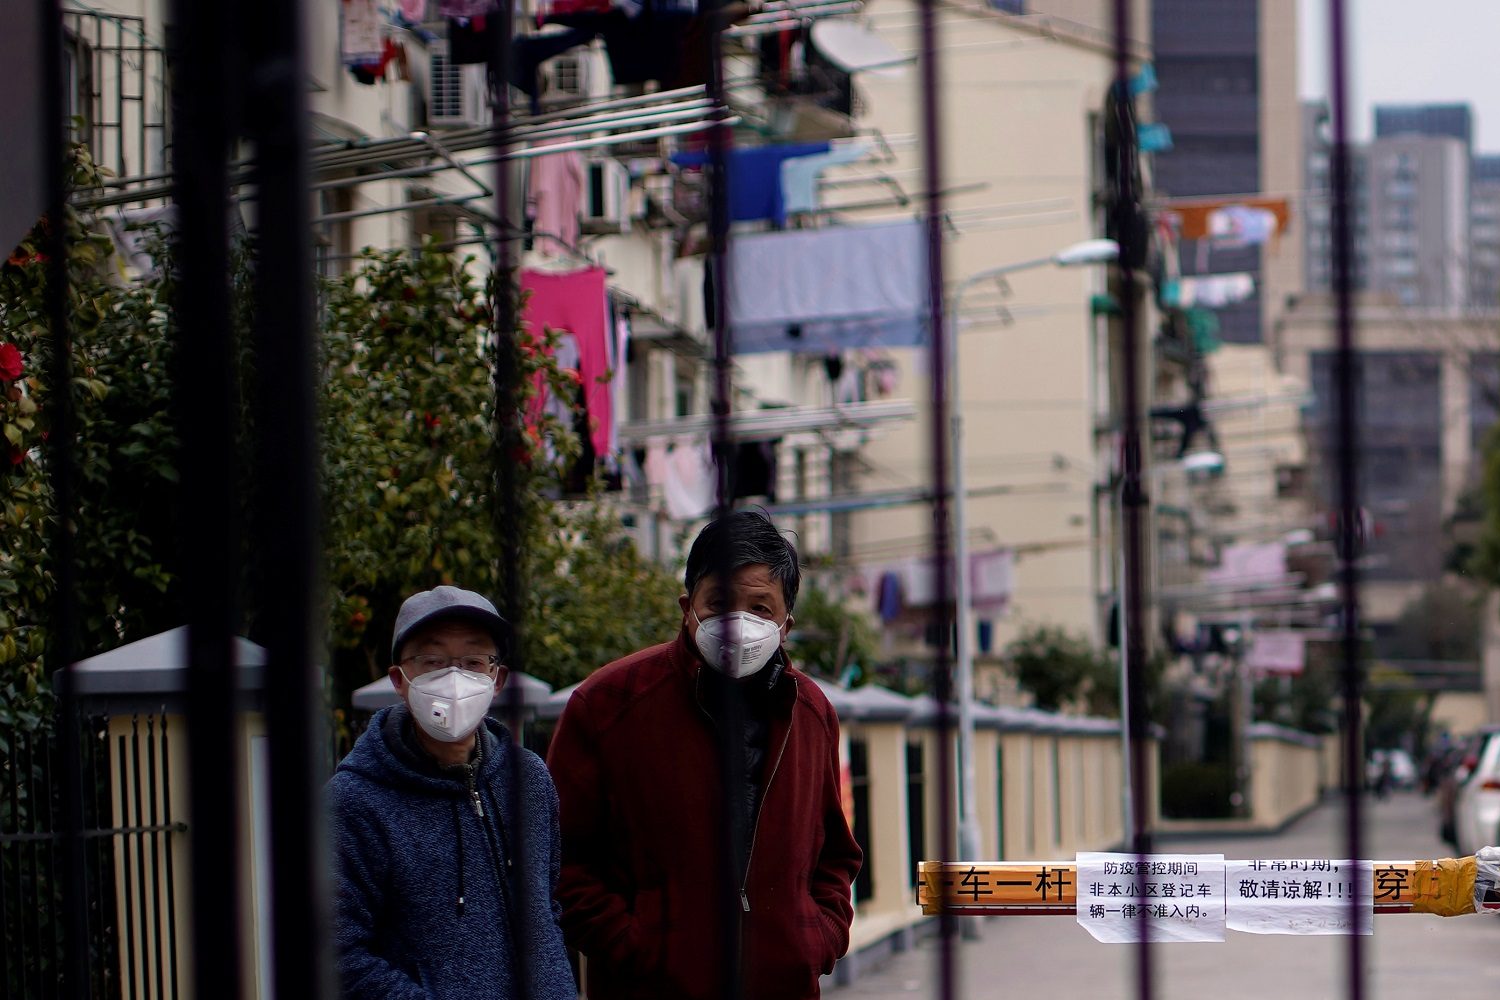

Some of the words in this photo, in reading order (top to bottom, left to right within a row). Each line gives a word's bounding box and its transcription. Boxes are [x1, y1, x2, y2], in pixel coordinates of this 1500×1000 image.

[1104, 861, 1199, 876] 防疫管控期间
[1089, 881, 1212, 897] 非本小区登记车
